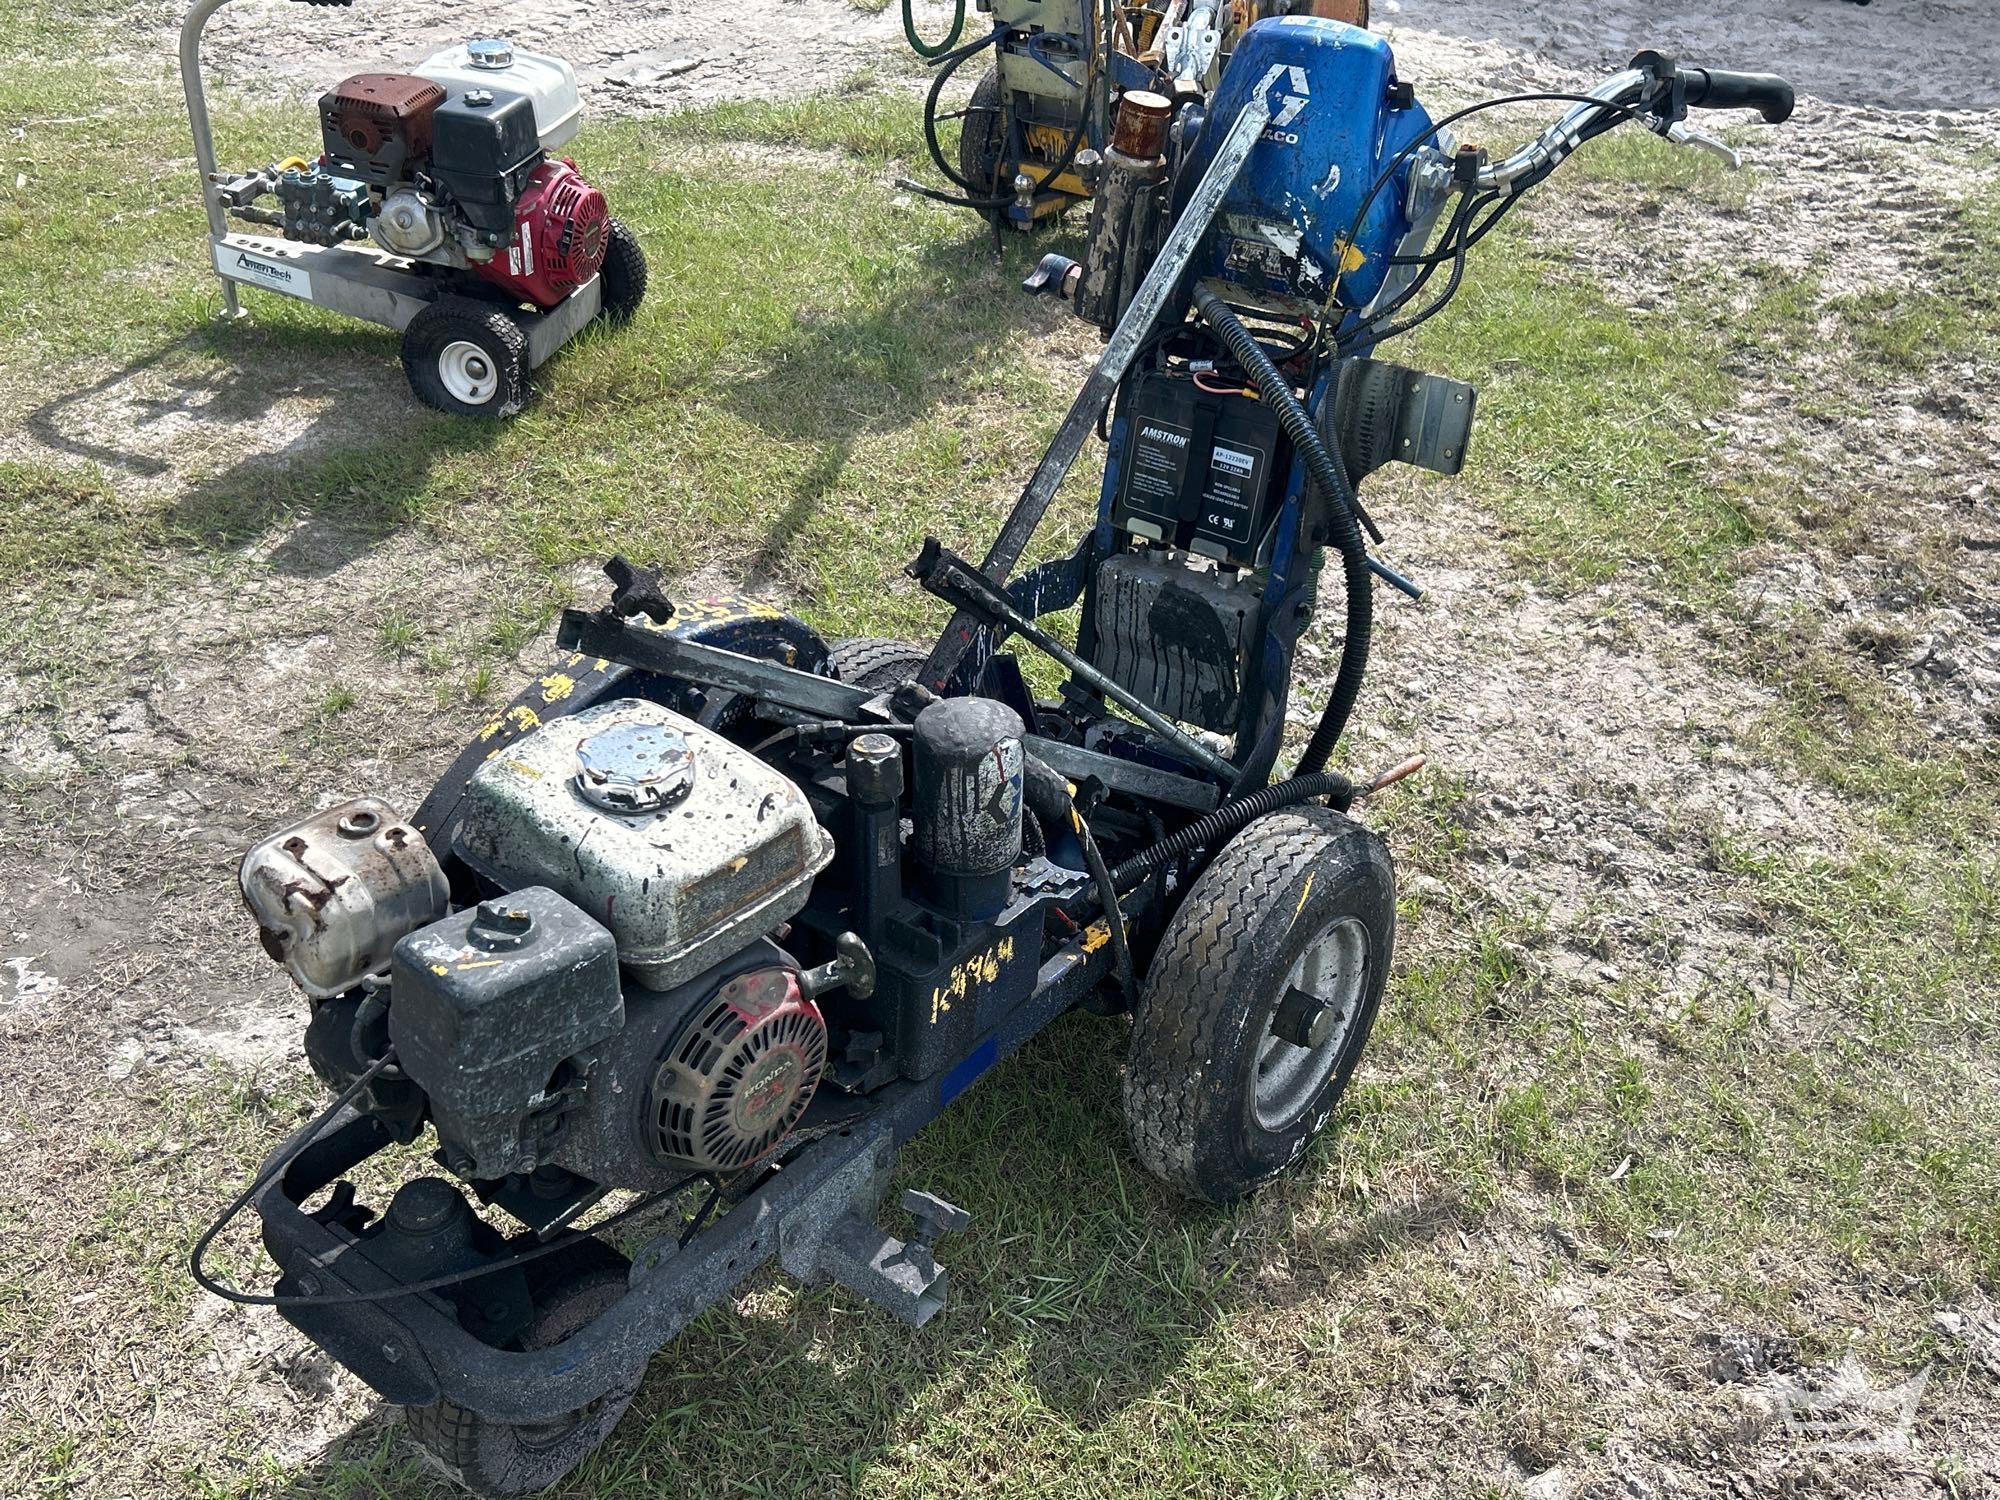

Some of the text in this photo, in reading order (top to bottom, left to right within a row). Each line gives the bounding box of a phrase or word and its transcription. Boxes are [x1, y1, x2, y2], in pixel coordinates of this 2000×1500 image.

[1262, 129, 1299, 145] ACO
[236, 253, 292, 281] AmeriTech
[1140, 426, 1188, 446] AMSTRON
[744, 1061, 793, 1099] HONDA
